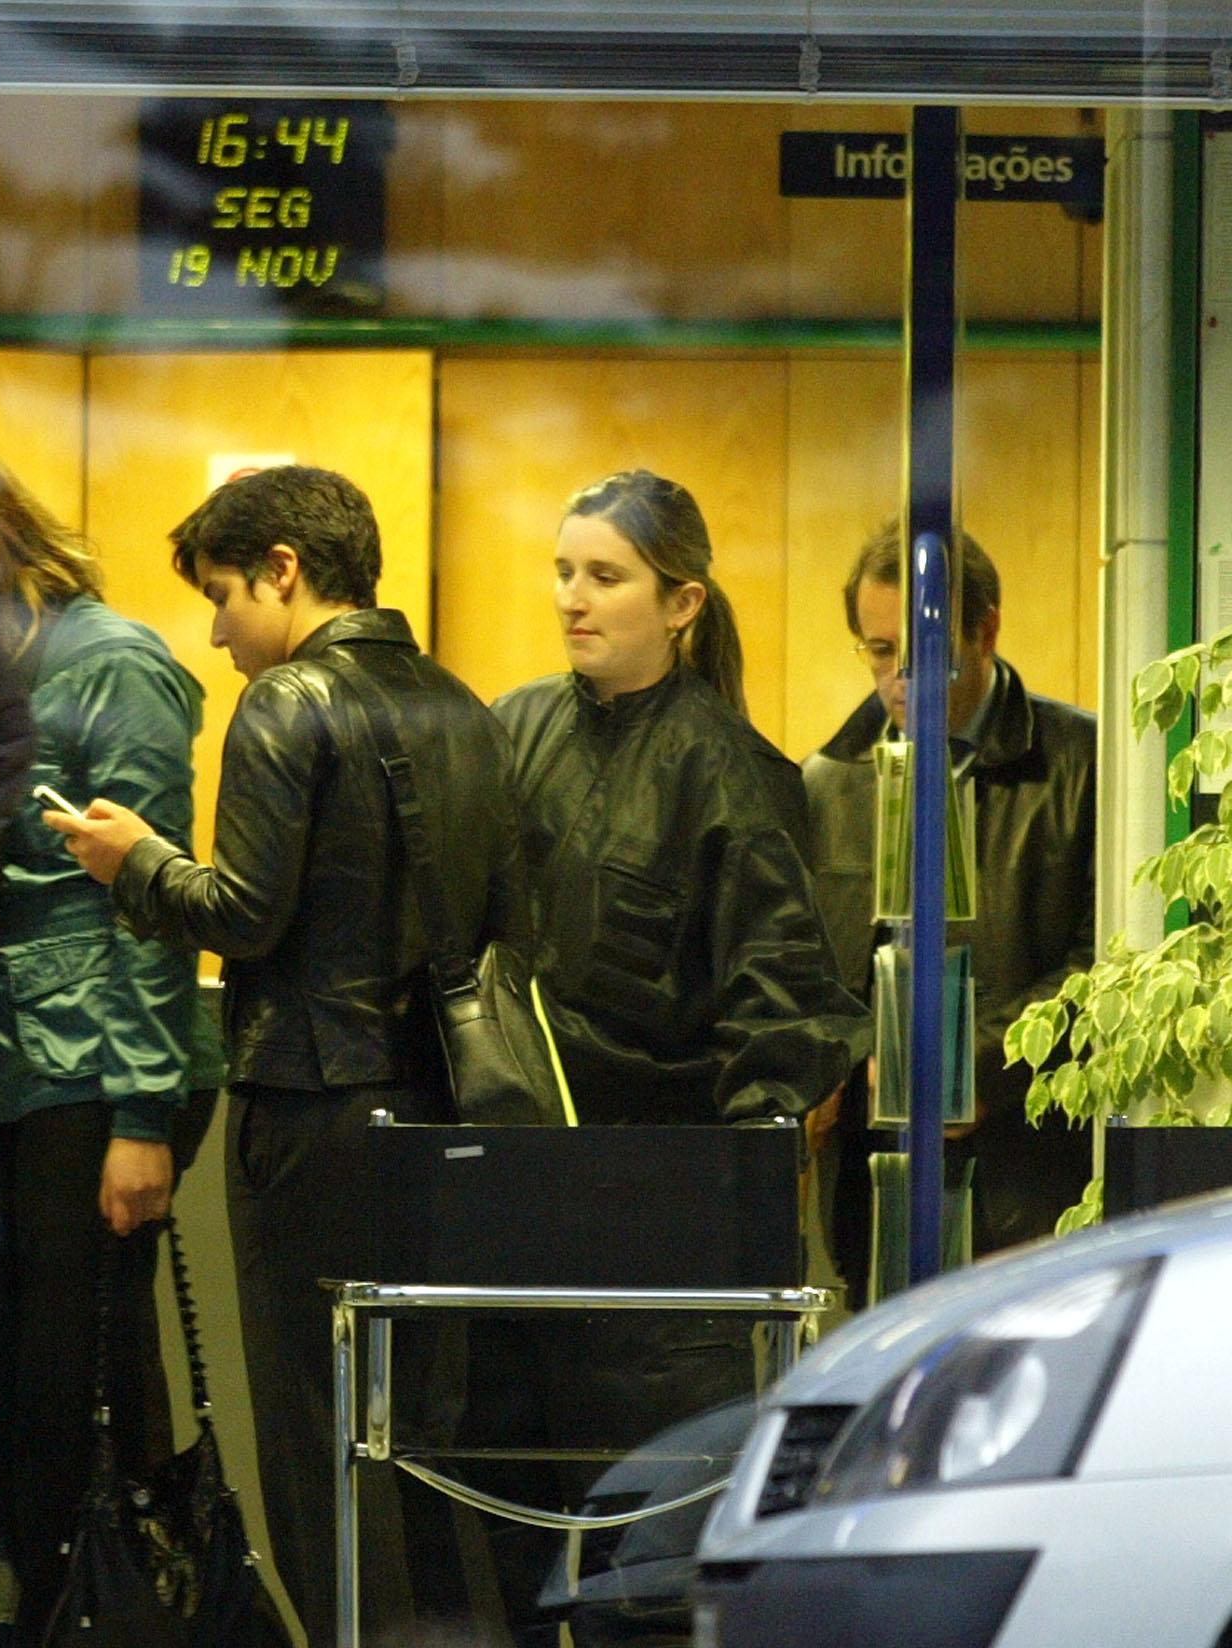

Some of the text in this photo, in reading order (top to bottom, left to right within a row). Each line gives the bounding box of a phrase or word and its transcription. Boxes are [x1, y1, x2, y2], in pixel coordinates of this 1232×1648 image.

[197, 112, 350, 168] 16:44
[834, 143, 1074, 191] Infoações
[211, 187, 313, 229] SEG
[169, 244, 340, 288] 19 NOV
